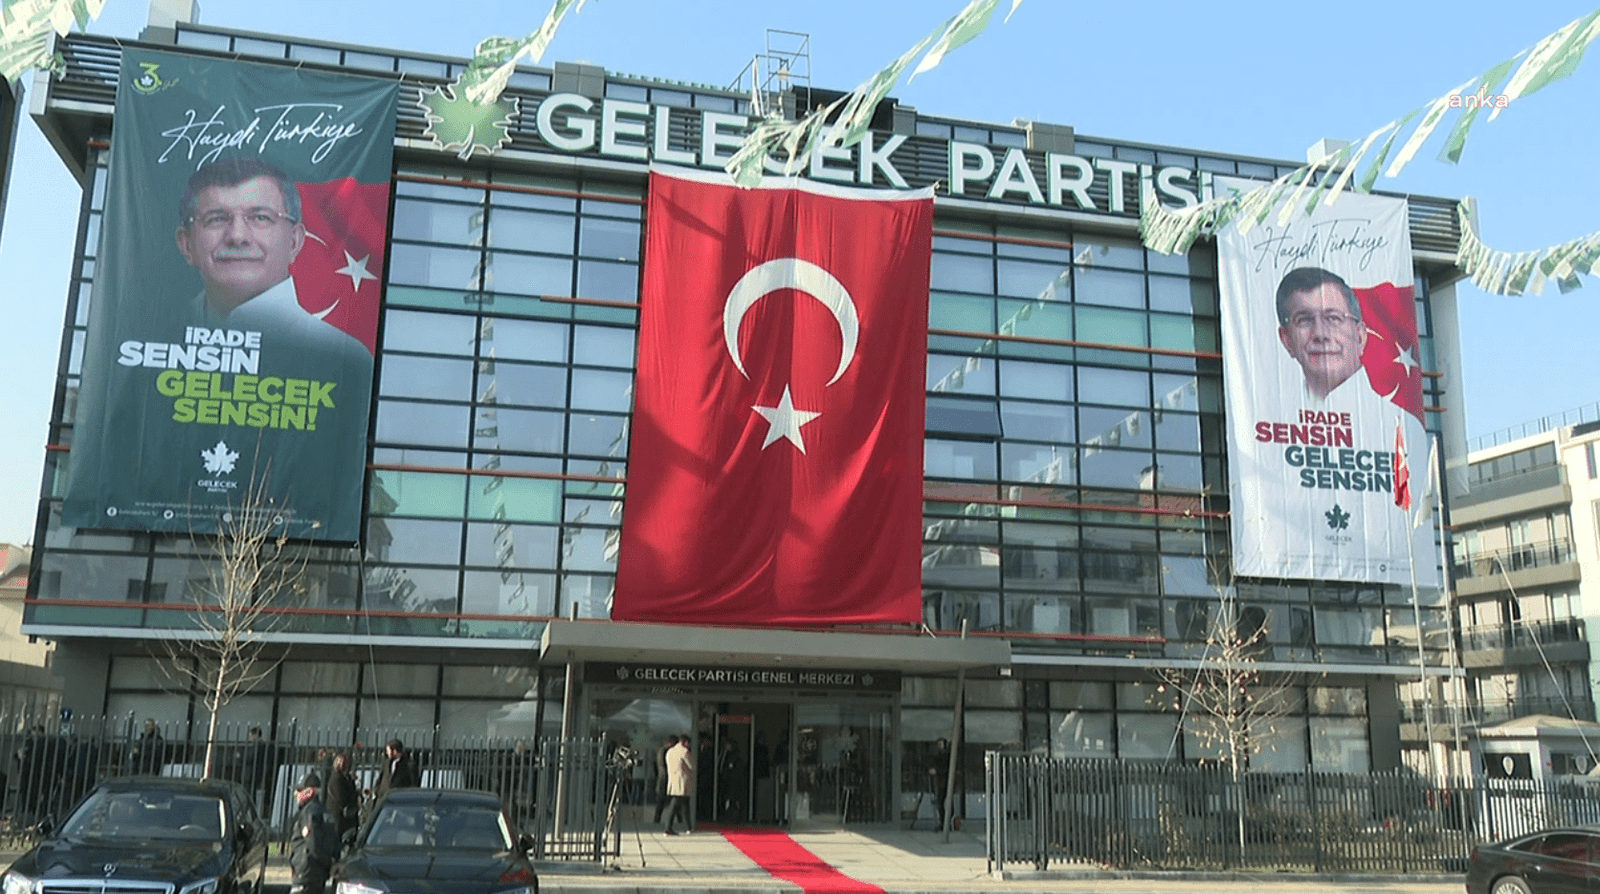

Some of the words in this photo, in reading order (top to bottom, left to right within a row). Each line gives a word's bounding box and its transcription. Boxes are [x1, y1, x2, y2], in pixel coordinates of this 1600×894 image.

[158, 105, 260, 170] Haydi
[254, 103, 363, 163] Türkiye
[1312, 218, 1389, 271] Türkiye
[156, 369, 337, 408] GELECEK
[634, 668, 696, 681] GELECEK
[751, 671, 795, 684] GENEL
